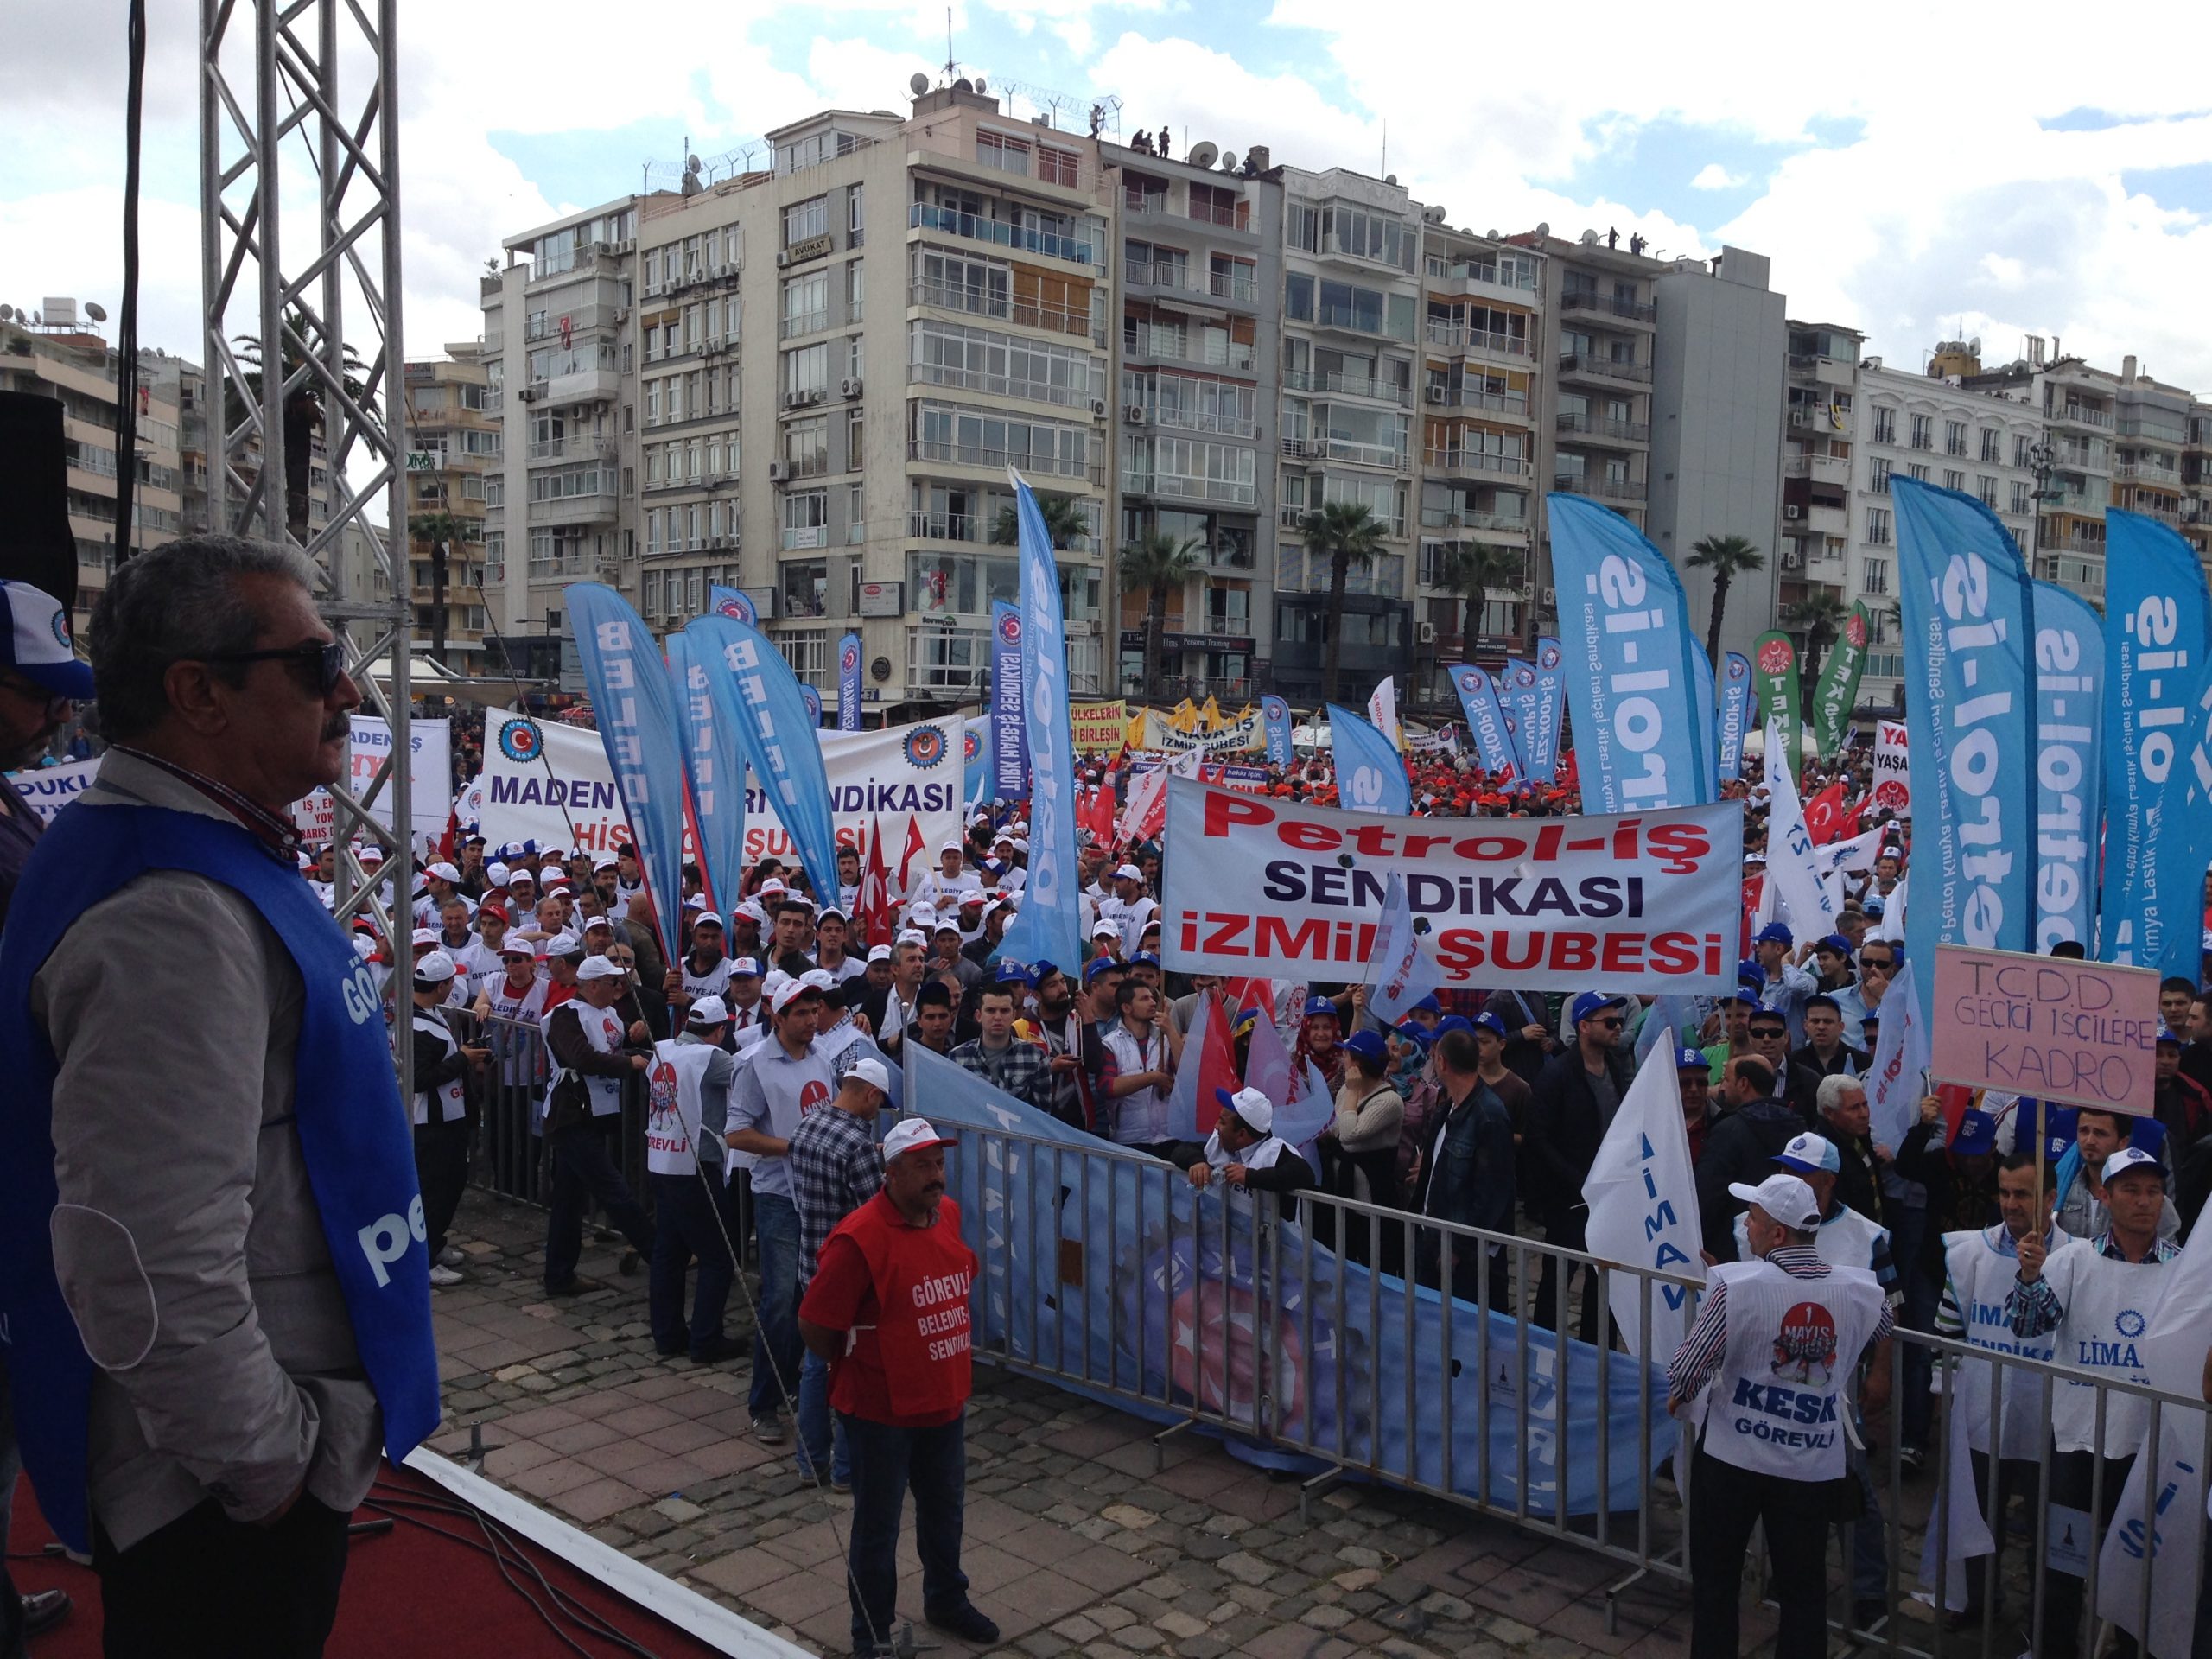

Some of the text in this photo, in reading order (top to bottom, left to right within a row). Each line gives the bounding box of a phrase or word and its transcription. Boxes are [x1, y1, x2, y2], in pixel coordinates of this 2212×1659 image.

[795, 241, 825, 256] AVUKAT
[1079, 724, 1121, 746] BİRLEŞİN
[490, 775, 953, 813] MADEN NDİKASI
[1986, 1040, 2133, 1102] KADRO
[810, 1084, 819, 1100] 1
[912, 1264, 970, 1308] GÖREVLİ
[1805, 1306, 1813, 1325] 1
[2078, 1334, 2145, 1369] LİMA
[1732, 1376, 1838, 1425] KESK
[1734, 1417, 1835, 1450] GÖREVLİ
